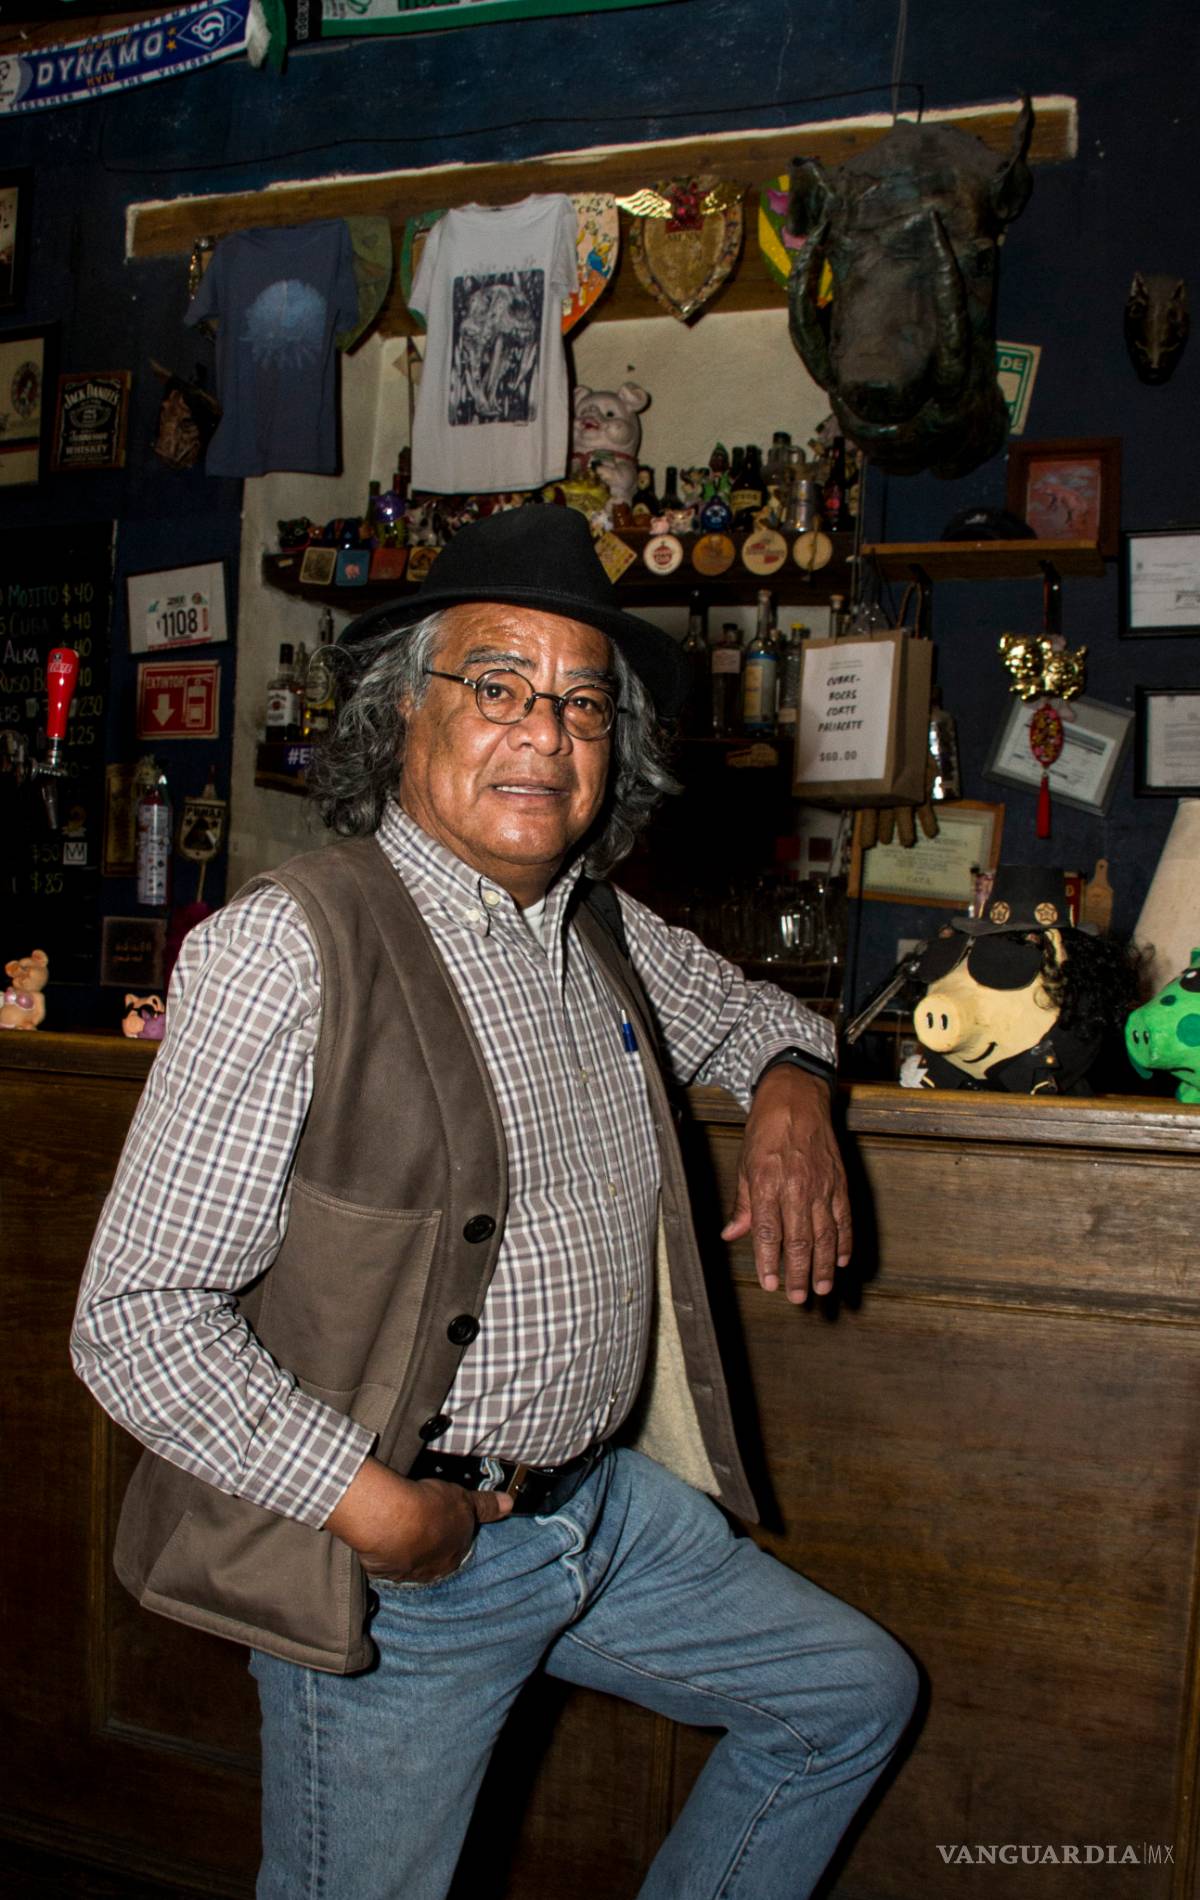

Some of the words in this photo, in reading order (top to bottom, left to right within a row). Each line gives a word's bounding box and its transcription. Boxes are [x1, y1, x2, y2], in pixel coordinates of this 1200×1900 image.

[36, 30, 163, 87] DYNAMO
[159, 53, 212, 77] VICTORY
[1000, 356, 1024, 372] DE
[64, 388, 86, 410] JACK
[65, 444, 110, 456] WHISKEY
[161, 608, 198, 637] 1108
[3, 639, 40, 664] ALKA
[826, 705, 857, 717] CORTE
[818, 720, 864, 733] PALIACATE
[819, 750, 858, 762] $60.00
